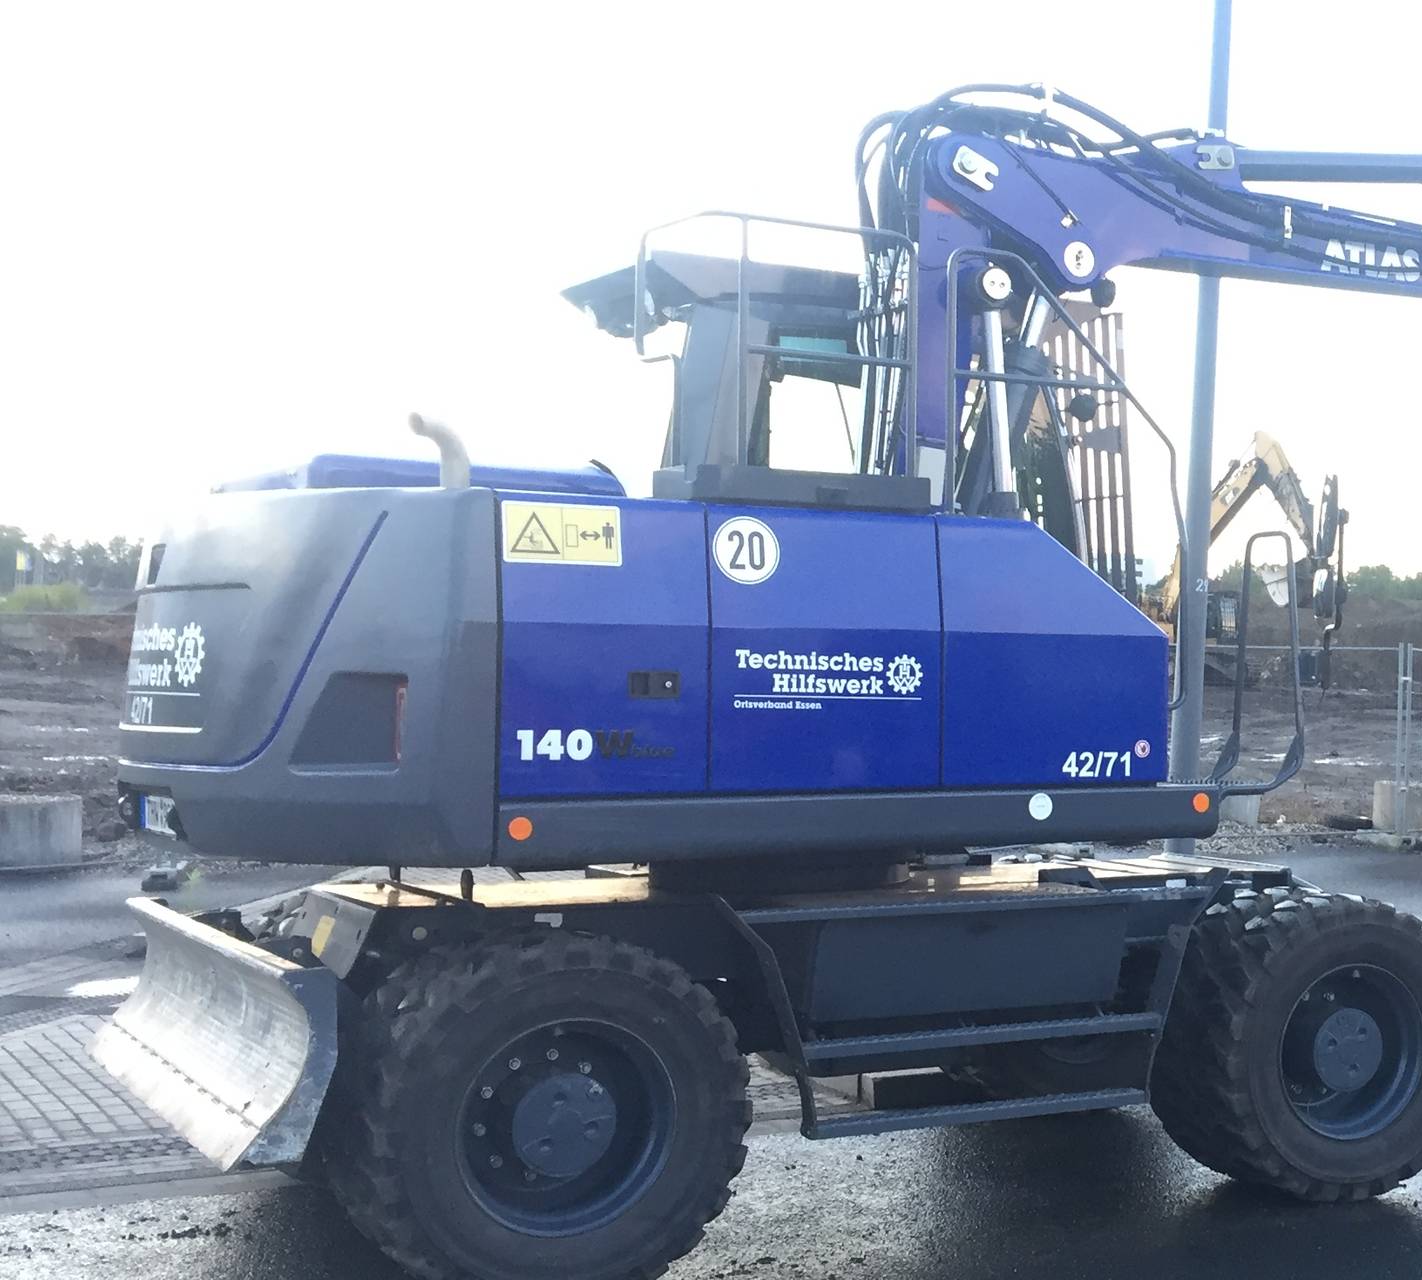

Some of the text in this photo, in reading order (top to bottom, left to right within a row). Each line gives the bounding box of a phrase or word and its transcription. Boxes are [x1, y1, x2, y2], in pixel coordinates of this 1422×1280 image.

[1320, 239, 1421, 282] ATLAS
[727, 530, 766, 571] 20
[735, 649, 884, 672] Technisches
[772, 673, 884, 695] Hilfswerk
[733, 700, 822, 710] Ortsverband Essen
[1061, 751, 1132, 778] 42/71
